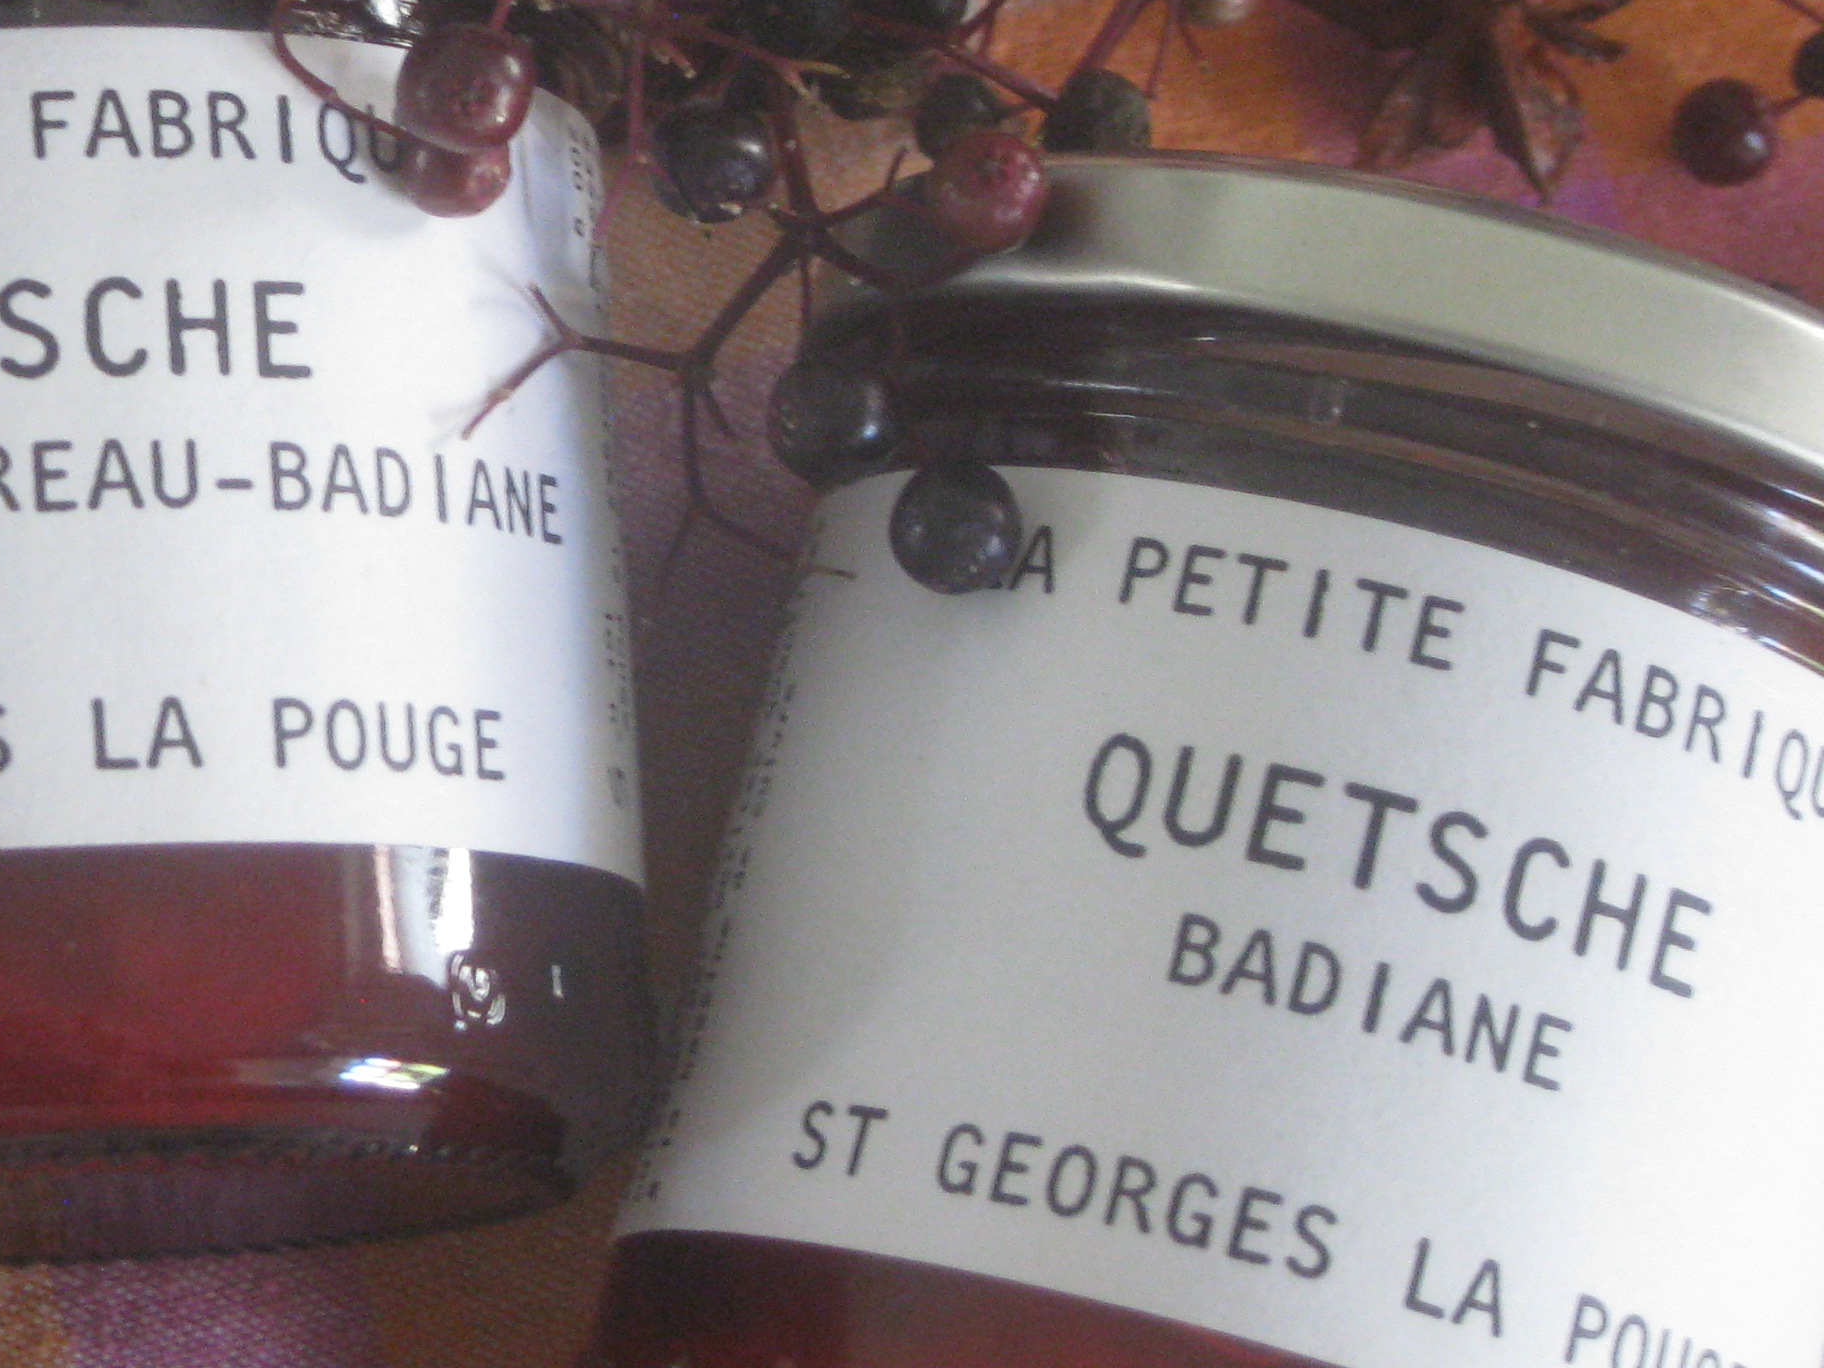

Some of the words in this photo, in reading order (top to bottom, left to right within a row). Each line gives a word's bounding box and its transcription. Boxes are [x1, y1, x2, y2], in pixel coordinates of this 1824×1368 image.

[30, 88, 404, 183] FABRIQU
[988, 523, 1055, 595] A
[1118, 537, 1465, 671] PETITE
[91, 696, 203, 770] LA
[273, 698, 505, 781] POUGE
[1084, 733, 1711, 998] QUETSCHE
[1167, 913, 1572, 1091] BADIANE
[792, 1100, 889, 1177] ST
[937, 1123, 1337, 1280] GEORGES
[1404, 1238, 1502, 1337] LA
